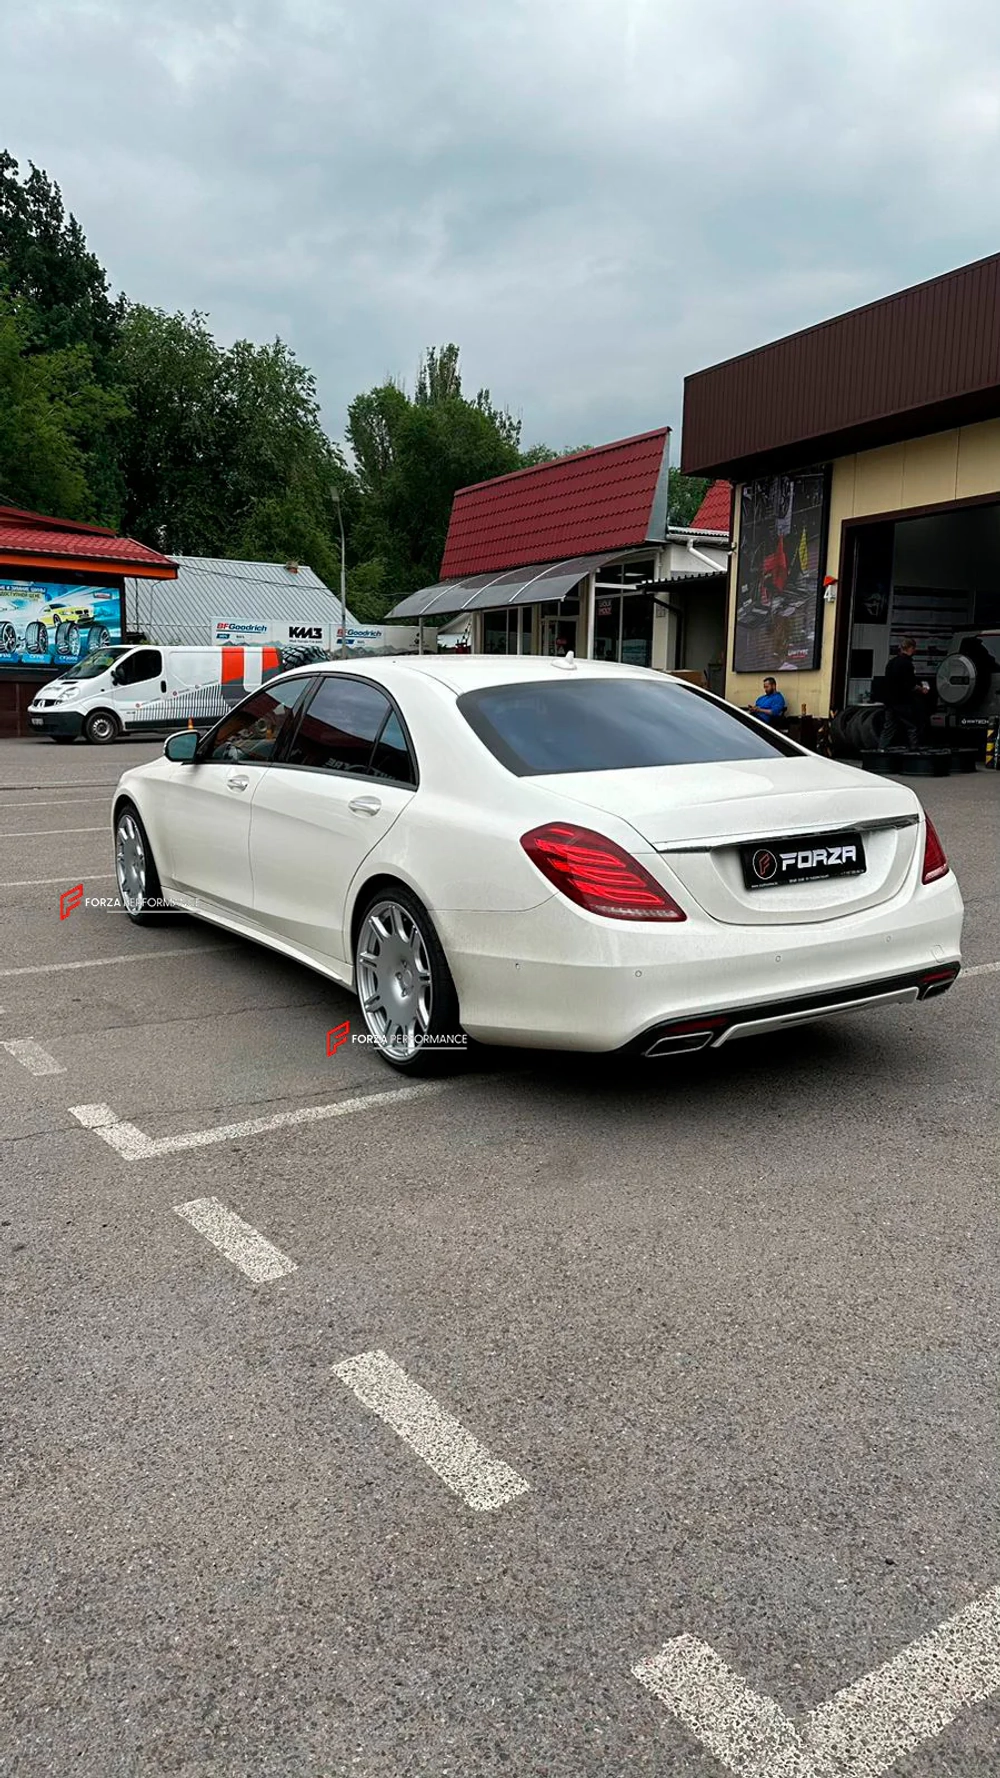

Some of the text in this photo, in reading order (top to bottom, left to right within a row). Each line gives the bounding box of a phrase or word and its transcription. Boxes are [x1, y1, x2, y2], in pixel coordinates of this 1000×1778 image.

[217, 622, 267, 632] BFGoodrich
[289, 626, 322, 639] KM3
[779, 845, 856, 871] FORZA
